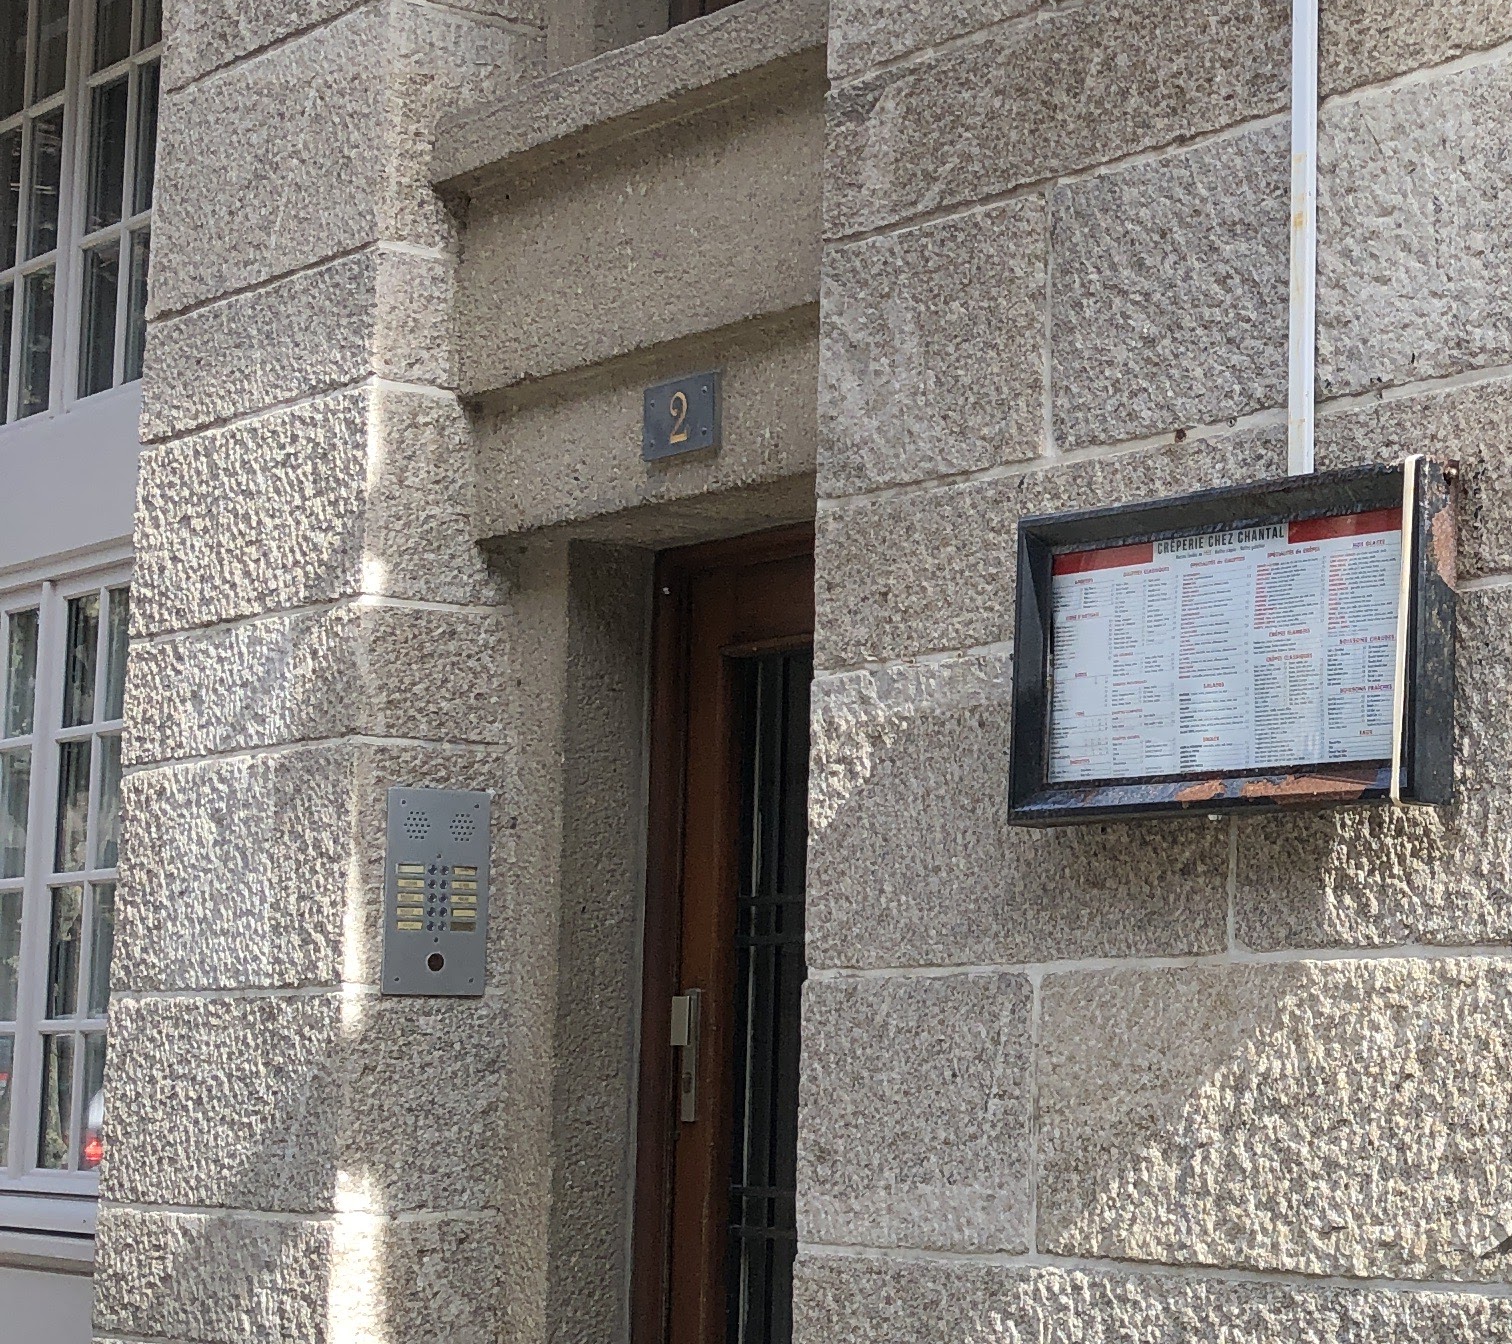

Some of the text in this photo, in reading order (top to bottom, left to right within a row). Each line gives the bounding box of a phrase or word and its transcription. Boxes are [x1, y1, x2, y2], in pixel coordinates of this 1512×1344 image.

[669, 391, 689, 444] 2
[1157, 537, 1204, 555] CRÊPERIE
[1208, 531, 1234, 548] CHEZ
[1237, 526, 1285, 544] CHANTAL
